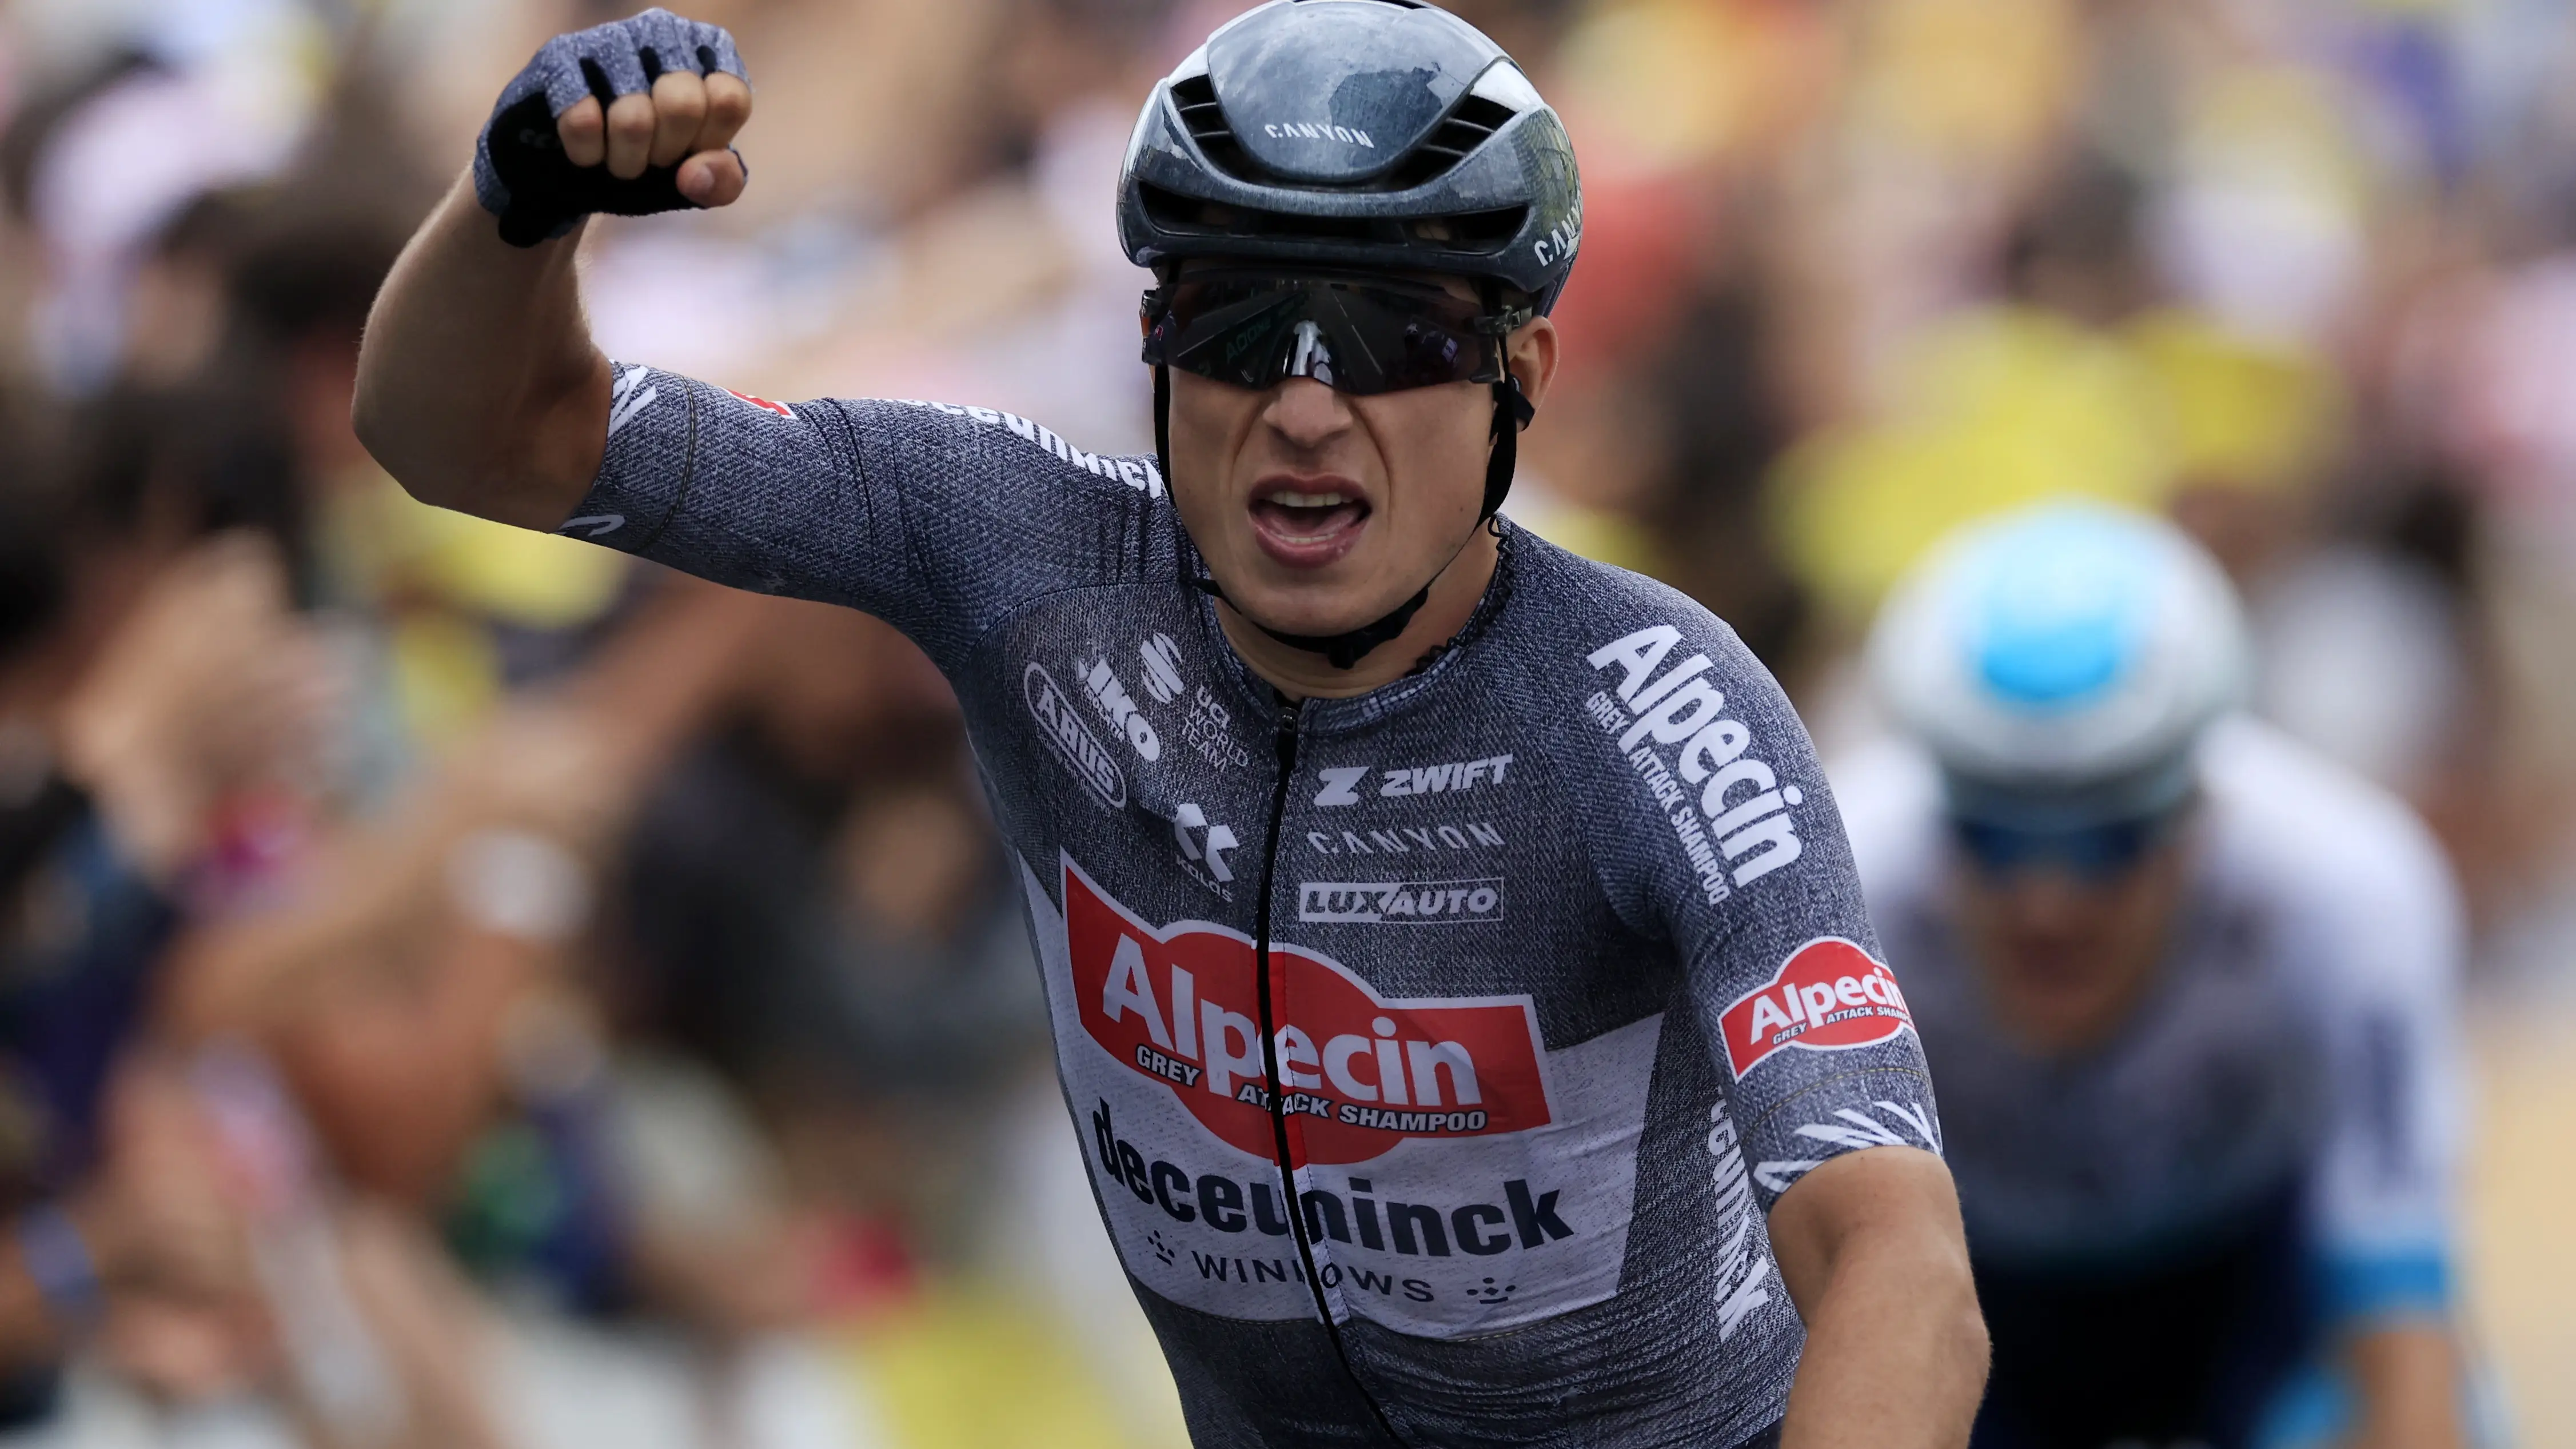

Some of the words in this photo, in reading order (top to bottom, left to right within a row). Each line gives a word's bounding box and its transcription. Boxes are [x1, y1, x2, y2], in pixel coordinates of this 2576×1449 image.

[1265, 122, 1374, 149] CANYON
[1036, 684, 1114, 795] ABUS
[1182, 717, 1227, 773] TEAM
[1190, 699, 1249, 767] WORLD
[1586, 625, 1803, 889] Alpecin
[1380, 753, 1513, 797] ZWIFT
[1585, 690, 1629, 735] GREY
[1628, 746, 1684, 811] ATTACK
[1670, 807, 1730, 907] SHAMPOO
[1307, 823, 1506, 854] CANYON
[1305, 887, 1499, 915] LUXAUTO
[1102, 932, 1482, 1107] Alpecin
[1750, 967, 1911, 1045] Alpecin
[1772, 1022, 1807, 1045] GREY
[1825, 1006, 1874, 1024] ATTACK
[1136, 1045, 1202, 1087] GREY
[1237, 1083, 1331, 1119] ATACK
[1339, 1103, 1488, 1132] SHAMPOO
[1092, 1096, 1574, 1258] deceuninck
